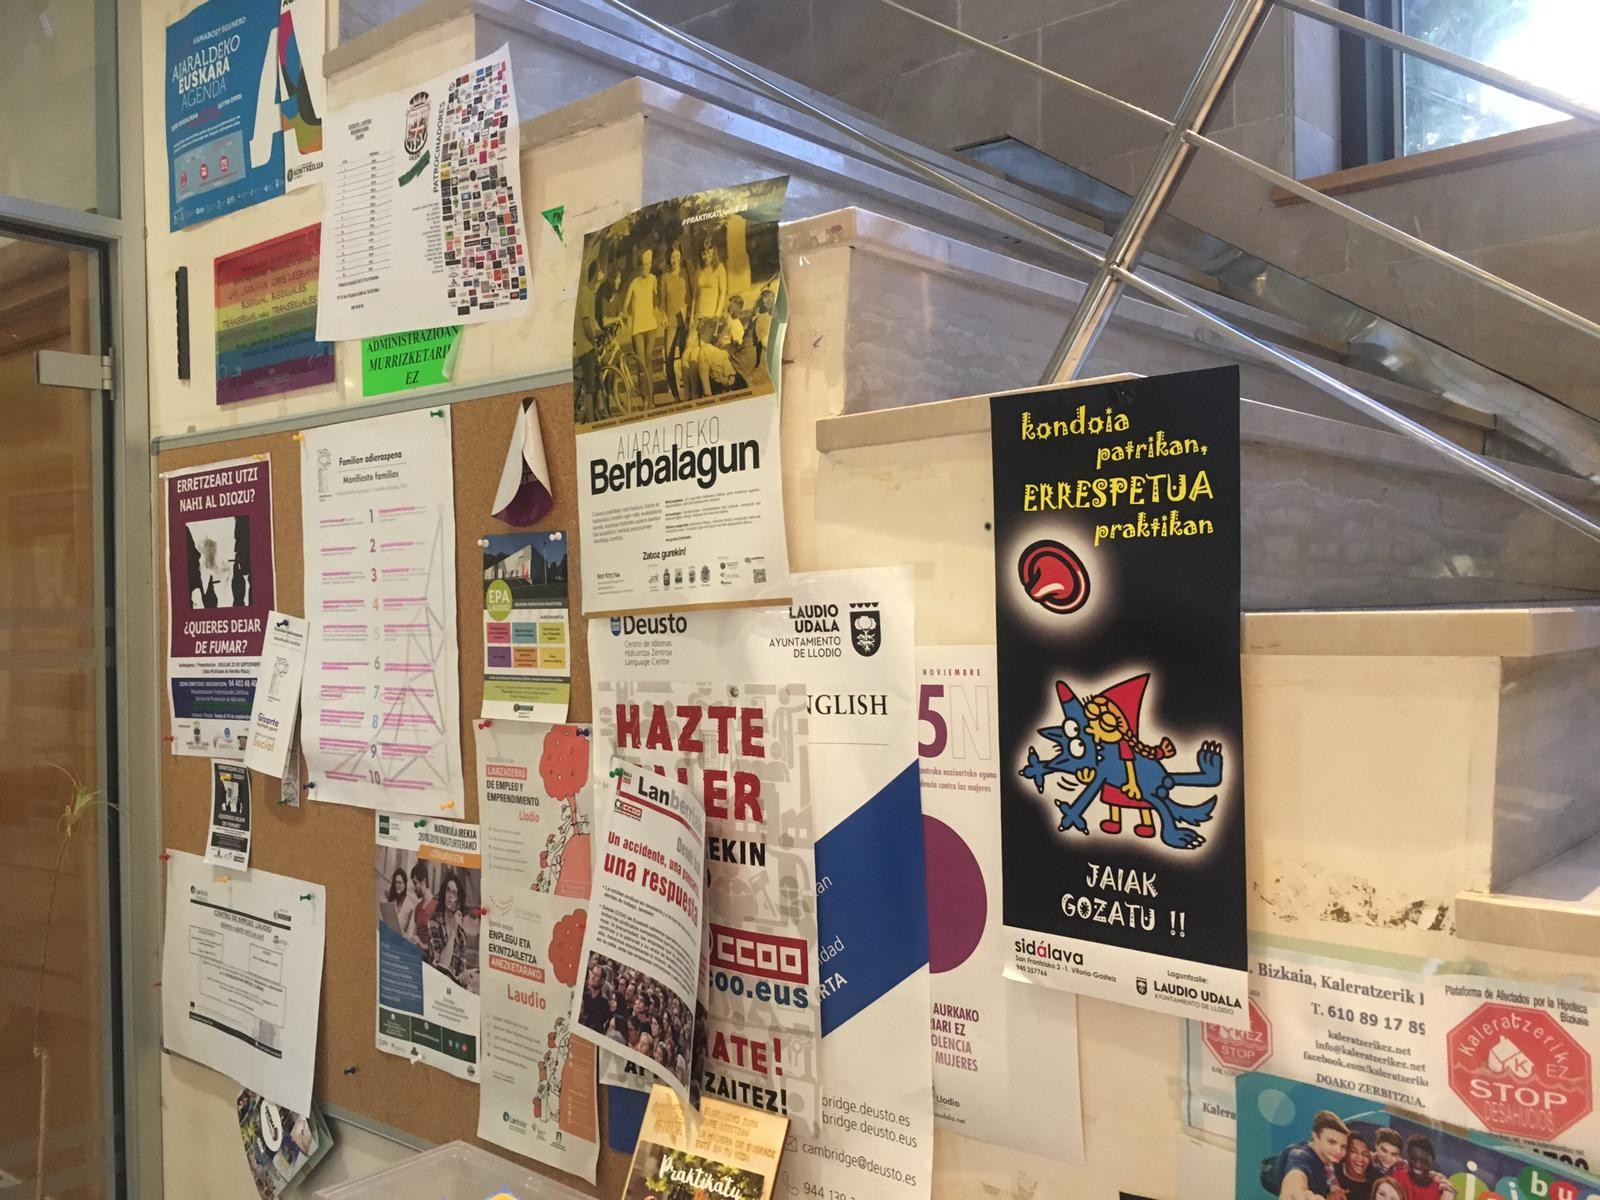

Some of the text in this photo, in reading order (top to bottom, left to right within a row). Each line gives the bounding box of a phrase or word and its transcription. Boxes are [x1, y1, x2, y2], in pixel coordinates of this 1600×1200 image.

[171, 34, 241, 83] AIARALDEKO
[178, 56, 231, 95] EUSKARA
[181, 79, 227, 111] AGENDA
[432, 101, 446, 194] PATROCINADORES
[367, 325, 460, 354] ADMINISTRAZIOAN
[405, 371, 420, 386] EZ
[1022, 405, 1130, 440] kondoia
[616, 416, 720, 461] AIARALDEKO
[1096, 430, 1208, 470] patrikan,
[339, 451, 402, 467] Familien adierazpena
[590, 439, 760, 495] Berbalagun
[177, 467, 258, 493] ERRETZEARI UTZI
[343, 470, 399, 484] Manifiesto familias
[180, 488, 256, 512] NAHI AL DIOZU?
[1024, 470, 1214, 512] ERRESPETUA
[369, 509, 374, 523] 1
[1093, 510, 1214, 547] praktikan
[370, 538, 376, 553] 2
[371, 568, 377, 582] 3
[488, 590, 511, 603] EPA
[789, 604, 839, 619] LAUDIO
[183, 618, 262, 638] ¿QUIERES DEJAR
[624, 613, 687, 635] Deusto
[795, 619, 840, 633] UDALA
[195, 640, 248, 654] DE FUMAR?
[624, 640, 642, 648] Centro
[769, 636, 841, 647] AYUNTAMIENTO
[794, 648, 842, 658] DE LLODIO
[374, 656, 381, 670] 6
[922, 668, 981, 676] NOVIEMBRE
[372, 714, 379, 729] 8
[616, 704, 766, 758] HAZTE
[371, 744, 377, 758] 9
[369, 770, 381, 785] 10
[486, 780, 524, 791] DE EMPLEO Y
[486, 792, 540, 807] EMPRENDIMIENTO
[458, 828, 477, 839] IREKIA
[608, 831, 620, 846] Un
[623, 839, 667, 868] accidente,
[708, 836, 766, 867] EKIN
[604, 853, 637, 883] una
[641, 867, 699, 928] respuesta
[1086, 862, 1158, 898] JAIAK
[1061, 893, 1186, 938] GOZATU !!
[488, 930, 531, 950] ENPLEGU ETA
[1014, 938, 1084, 966] sidálava
[488, 943, 537, 965] EKINTZAILETZA
[717, 934, 802, 975] CCOO
[1015, 955, 1027, 964] San
[1027, 957, 1056, 970] Frantzisko
[1071, 966, 1117, 983] Vitoria-Gasteiz
[1166, 969, 1209, 985] Laguntzaile:
[710, 972, 809, 1009] oo.eus
[1153, 980, 1243, 1010] LAUDIO UDALA
[1258, 962, 1416, 1004] Bizkaia, Kaleratzerik
[507, 984, 546, 1010] Laudio
[1154, 993, 1235, 1016] AYUNTAMIENTO DE LLODIO
[1445, 985, 1588, 1014] Plataforma de Afectados por la Hipoteca
[933, 1002, 980, 1022] AURKAKO
[1311, 1002, 1426, 1036] T. 610 89 17 89
[1560, 1012, 1589, 1027] Bizkaia
[954, 1022, 966, 1036] EZ
[1458, 1012, 1570, 1064] Kaleratzerik
[1221, 1045, 1256, 1060] STOP
[1328, 1029, 1412, 1057] kaleratzerikez.net
[935, 1051, 978, 1072] MUJERES
[1315, 1040, 1426, 1073] info@kaleratzerikez.net
[1546, 1064, 1570, 1079] EZ
[704, 1071, 788, 1115] ZAITEZ!
[936, 1095, 960, 1108] Llodio
[1316, 1073, 1426, 1109] DOAKO ZERBITZUA.
[1470, 1078, 1568, 1111] STOP
[802, 1142, 917, 1187] cambridge@deusto.es
[658, 1154, 743, 1200] Praktikatu
[804, 1181, 825, 1198] 944
